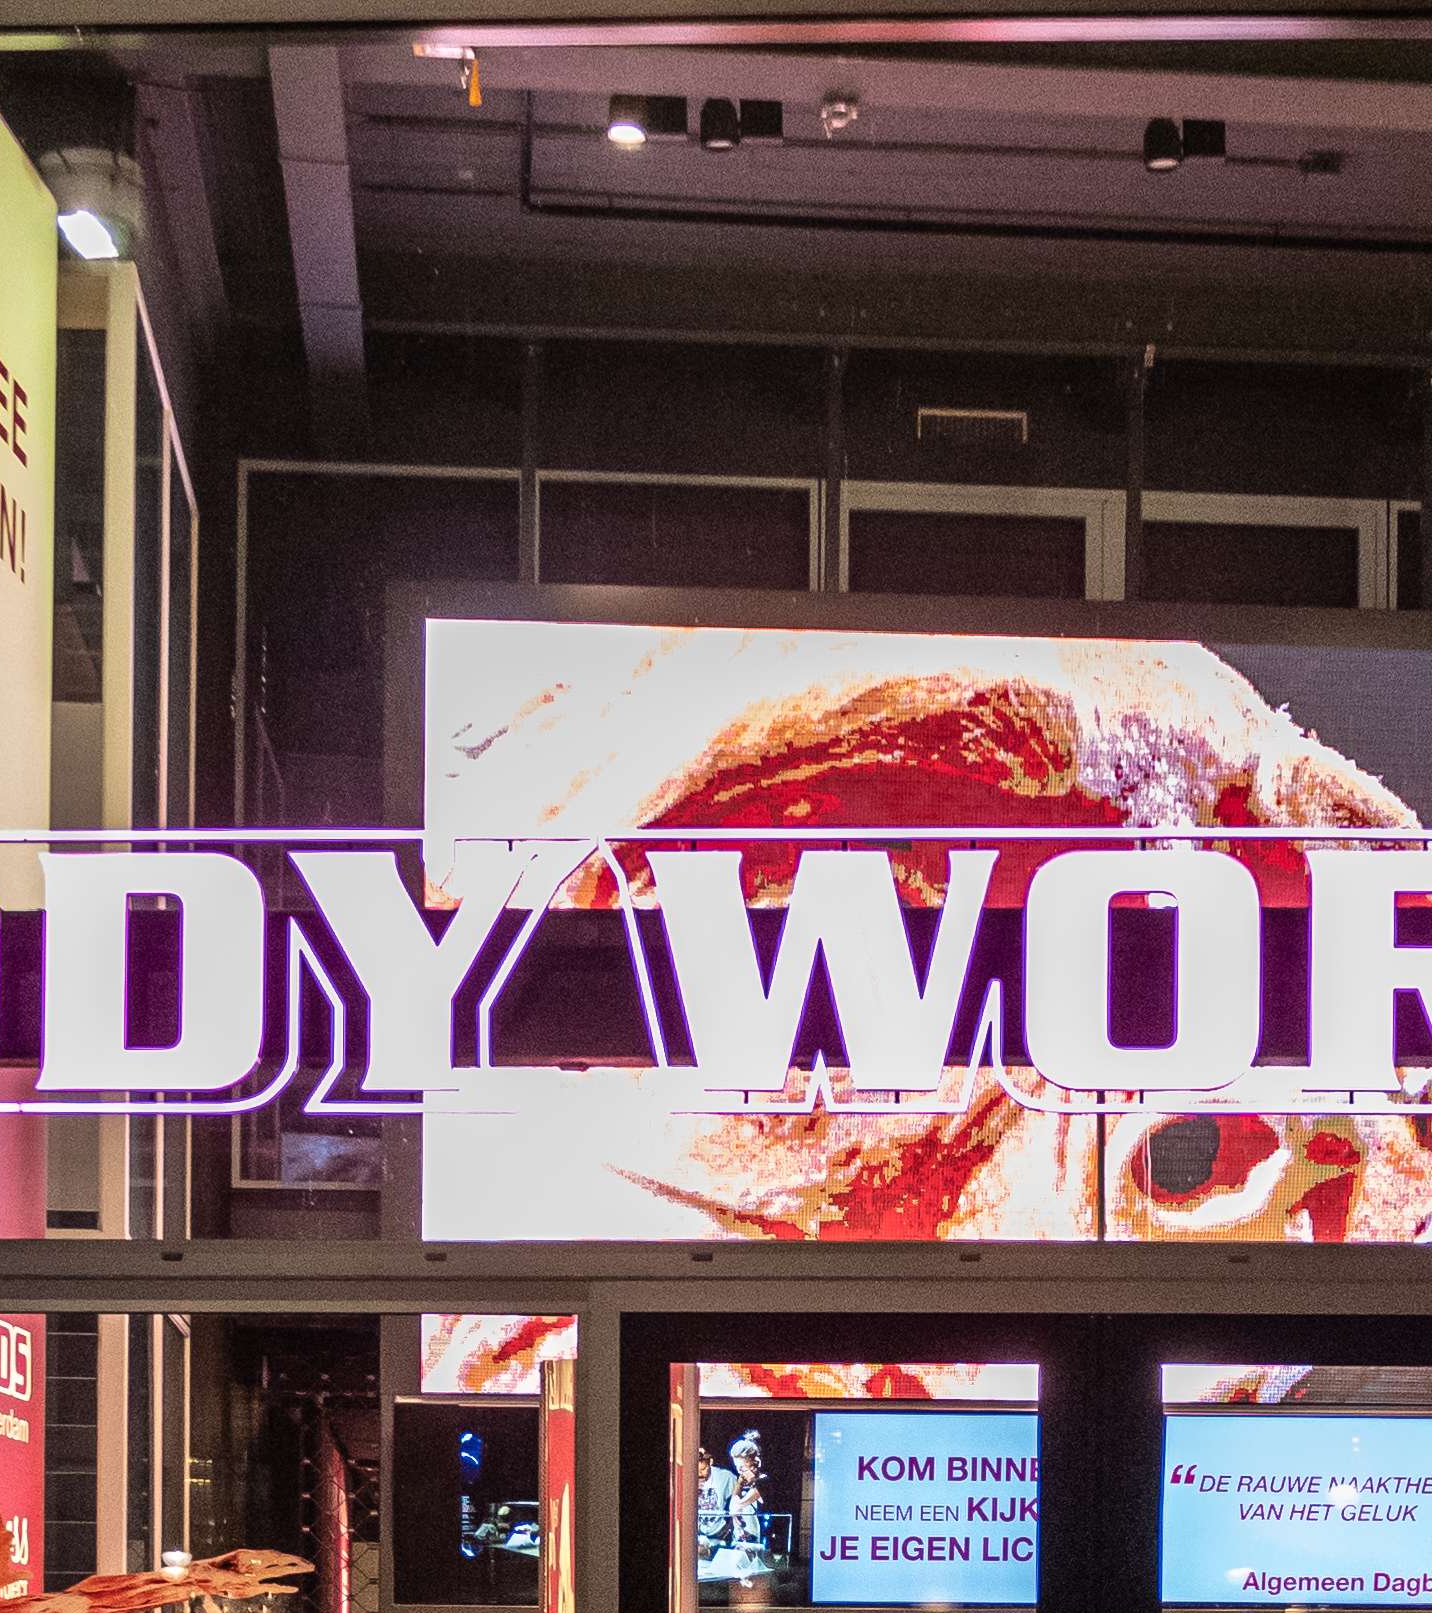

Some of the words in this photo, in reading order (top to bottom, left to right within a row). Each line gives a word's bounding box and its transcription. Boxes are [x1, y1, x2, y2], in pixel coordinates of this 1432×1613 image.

[857, 1456, 936, 1481] KOM
[1237, 1476, 1323, 1494] RAUWE
[855, 1505, 913, 1522] NEEM
[920, 1506, 960, 1522] EEN
[967, 1497, 1039, 1522] KIJK
[1239, 1504, 1283, 1521] VAN
[1289, 1504, 1334, 1521] HET
[1341, 1505, 1419, 1522] GELUK
[820, 1537, 859, 1562] JE
[871, 1536, 970, 1562] EIGEN
[982, 1537, 1034, 1562] LIC
[1242, 1572, 1364, 1595] Algemeen
